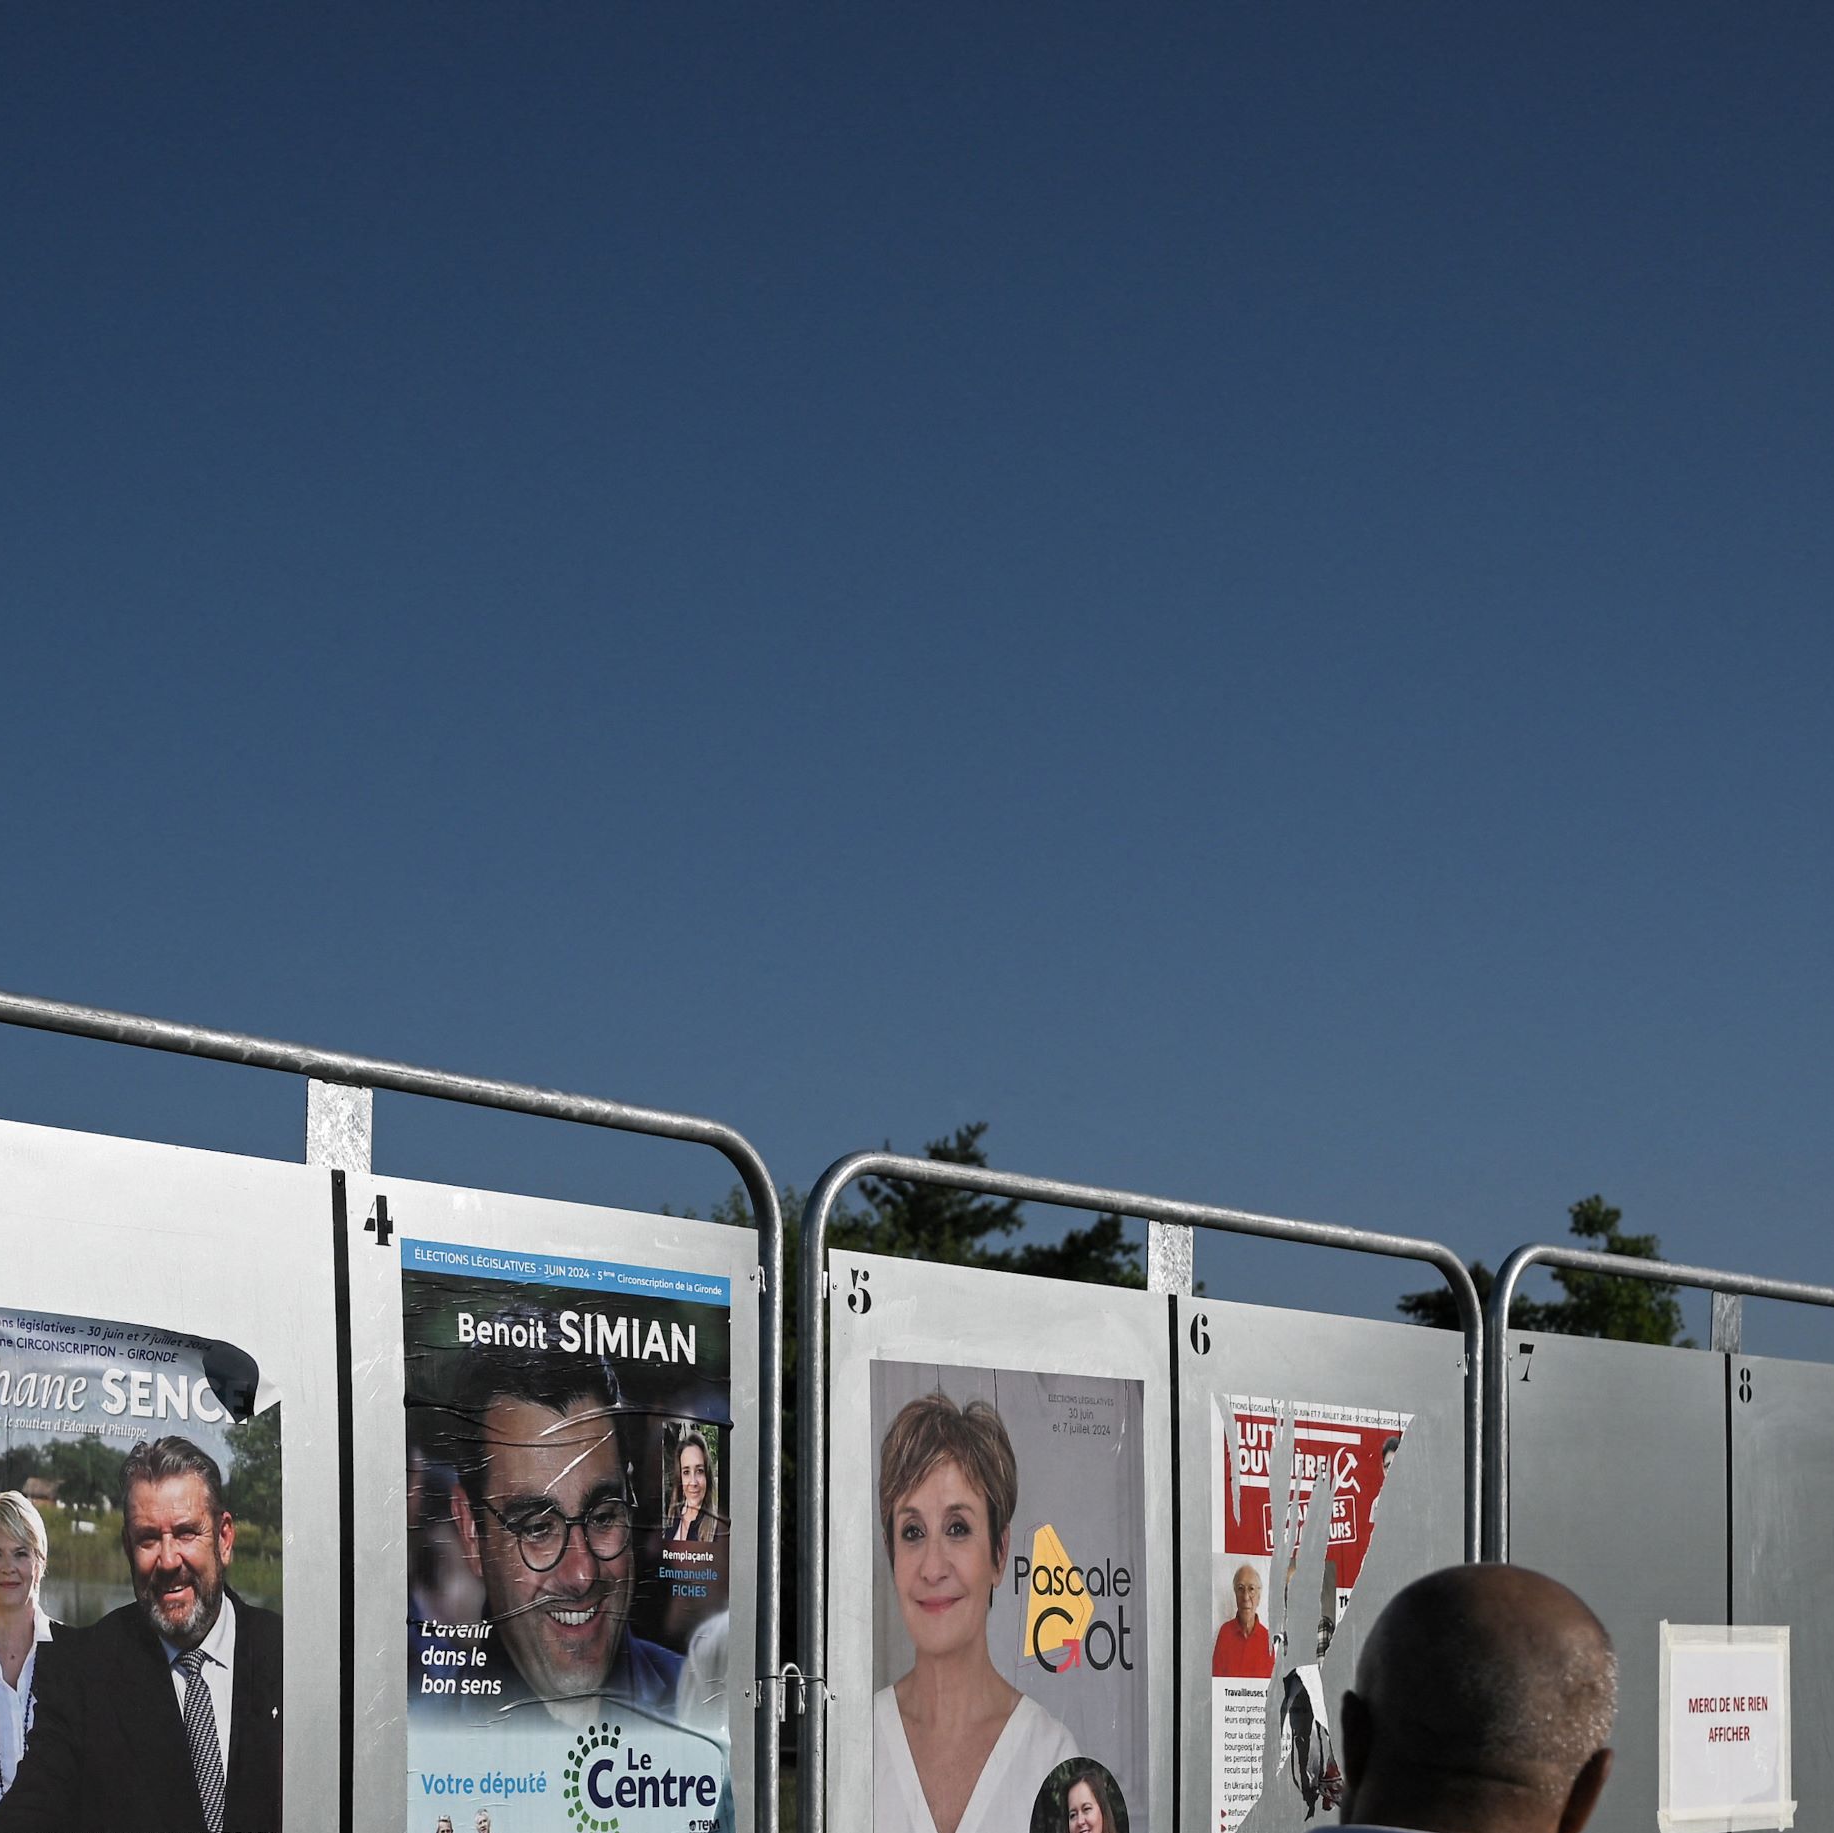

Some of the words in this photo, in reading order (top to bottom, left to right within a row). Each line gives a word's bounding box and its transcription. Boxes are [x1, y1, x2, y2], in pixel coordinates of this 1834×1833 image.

[363, 1194, 394, 1246] 4
[414, 1246, 469, 1266] ÉLECTIONS
[471, 1252, 537, 1274] LÉGISLATIVES
[543, 1262, 566, 1277] JUIN
[568, 1264, 590, 1279] 2024
[617, 1272, 675, 1290] Circonscription
[676, 1278, 685, 1290] de
[694, 1281, 723, 1296] Gironde
[847, 1268, 872, 1315] 5
[17, 1317, 76, 1335] législatives
[87, 1325, 100, 1337] 30
[102, 1327, 124, 1341] juin
[126, 1330, 140, 1342] et
[150, 1333, 183, 1348] juillet
[457, 1312, 548, 1350] Benoit
[558, 1309, 696, 1365] SIMIAN
[1190, 1313, 1211, 1356] 6
[16, 1337, 116, 1358] CIRCONSCRIPTION
[127, 1348, 178, 1363] GIRONDE
[1519, 1343, 1535, 1382] 7
[1739, 1367, 1753, 1404] 8
[5, 1415, 12, 1428] le
[15, 1416, 51, 1431] soutien
[108, 1424, 147, 1438] Philippe
[663, 1549, 714, 1563] Remplaçante
[659, 1567, 718, 1580] Emmanuelle
[1015, 1555, 1131, 1598] Pascale
[672, 1584, 707, 1597] FICHES
[421, 1620, 493, 1640] L'avenir
[1033, 1604, 1134, 1673] Got
[421, 1647, 467, 1667] dans
[471, 1648, 487, 1667] le
[421, 1674, 457, 1694] bon
[460, 1678, 502, 1695] sens
[1688, 1696, 1718, 1714] MERCI
[1719, 1697, 1731, 1713] DE
[1733, 1696, 1746, 1713] NE
[1748, 1695, 1768, 1713] RIEN
[1708, 1726, 1751, 1743] AFFICHER
[627, 1748, 652, 1771] Le
[421, 1773, 474, 1795] Votre
[479, 1770, 547, 1799] député
[587, 1759, 717, 1809] Centre
